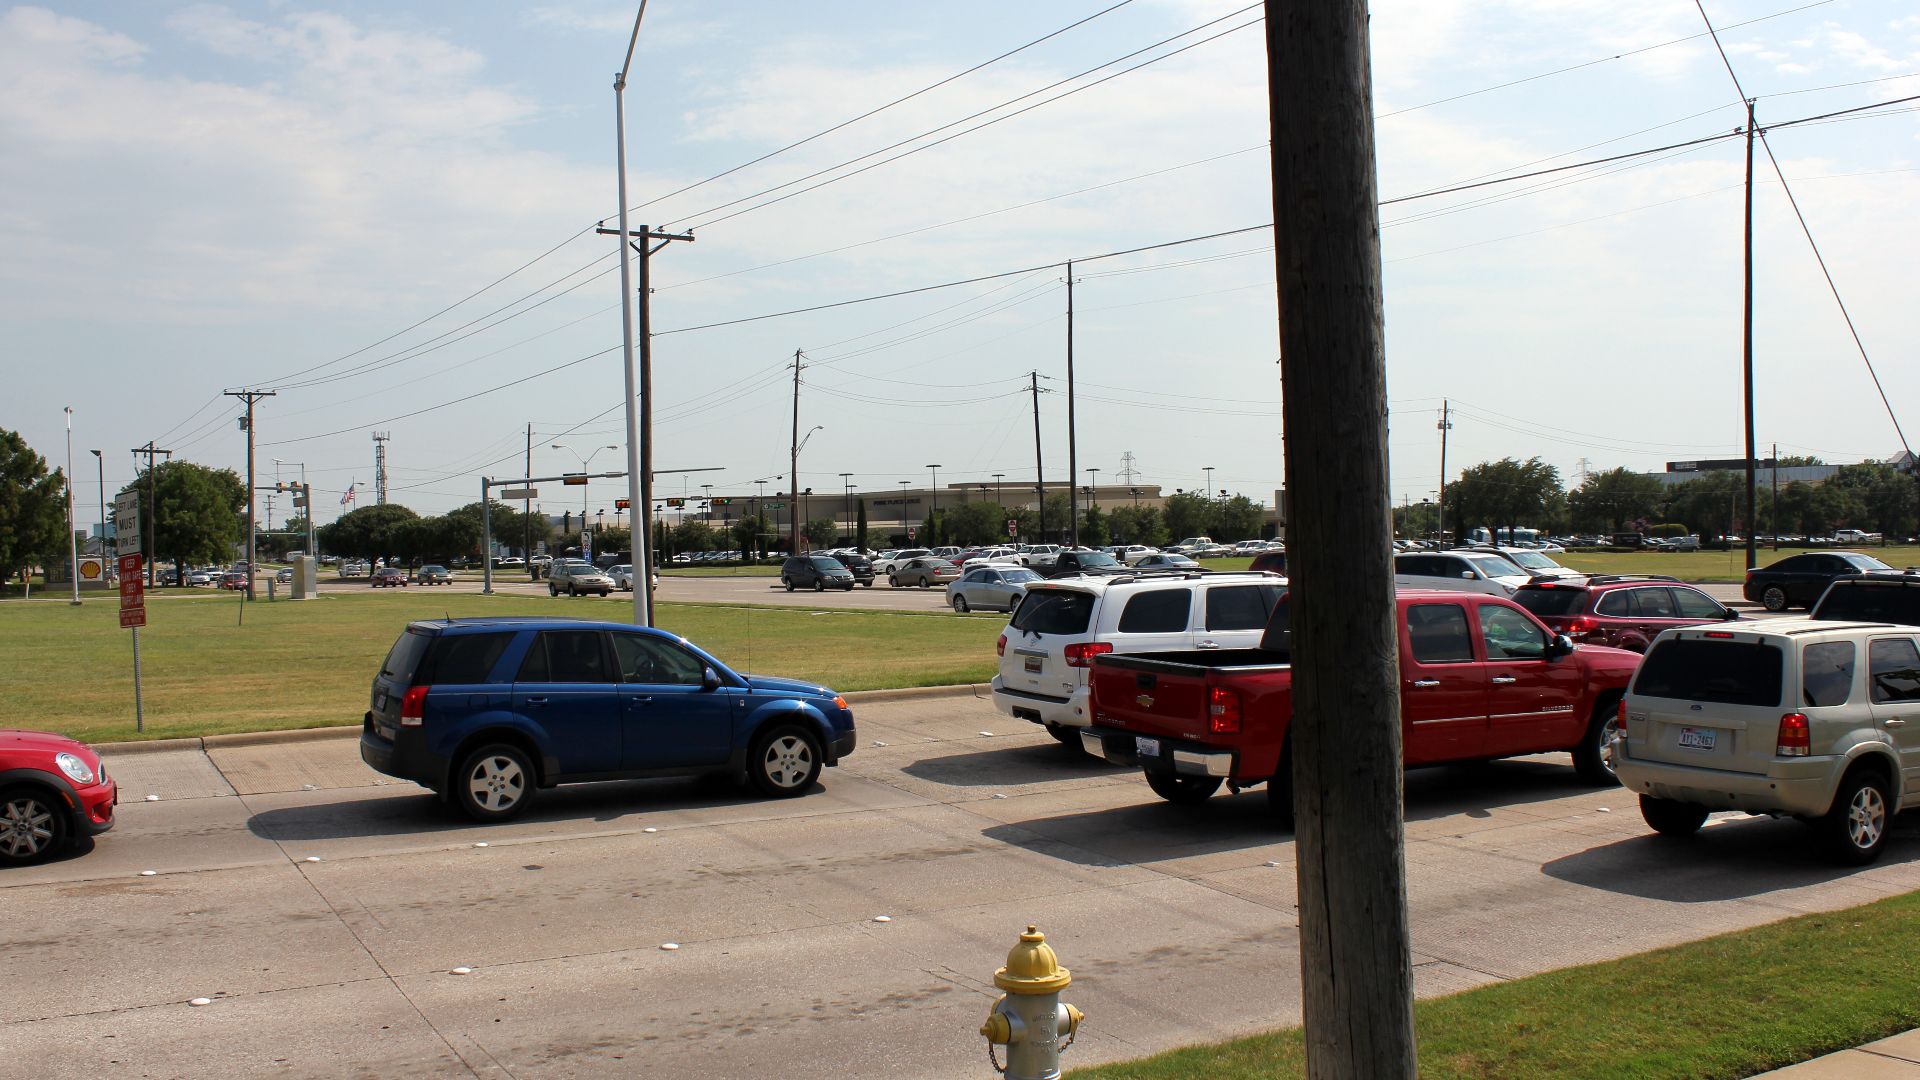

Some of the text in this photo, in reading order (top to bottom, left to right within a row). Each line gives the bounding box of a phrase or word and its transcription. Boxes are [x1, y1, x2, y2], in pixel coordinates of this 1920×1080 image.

[117, 499, 137, 512] LEFT LANE
[119, 516, 136, 531] MUST
[118, 535, 139, 548] TURN LEFT
